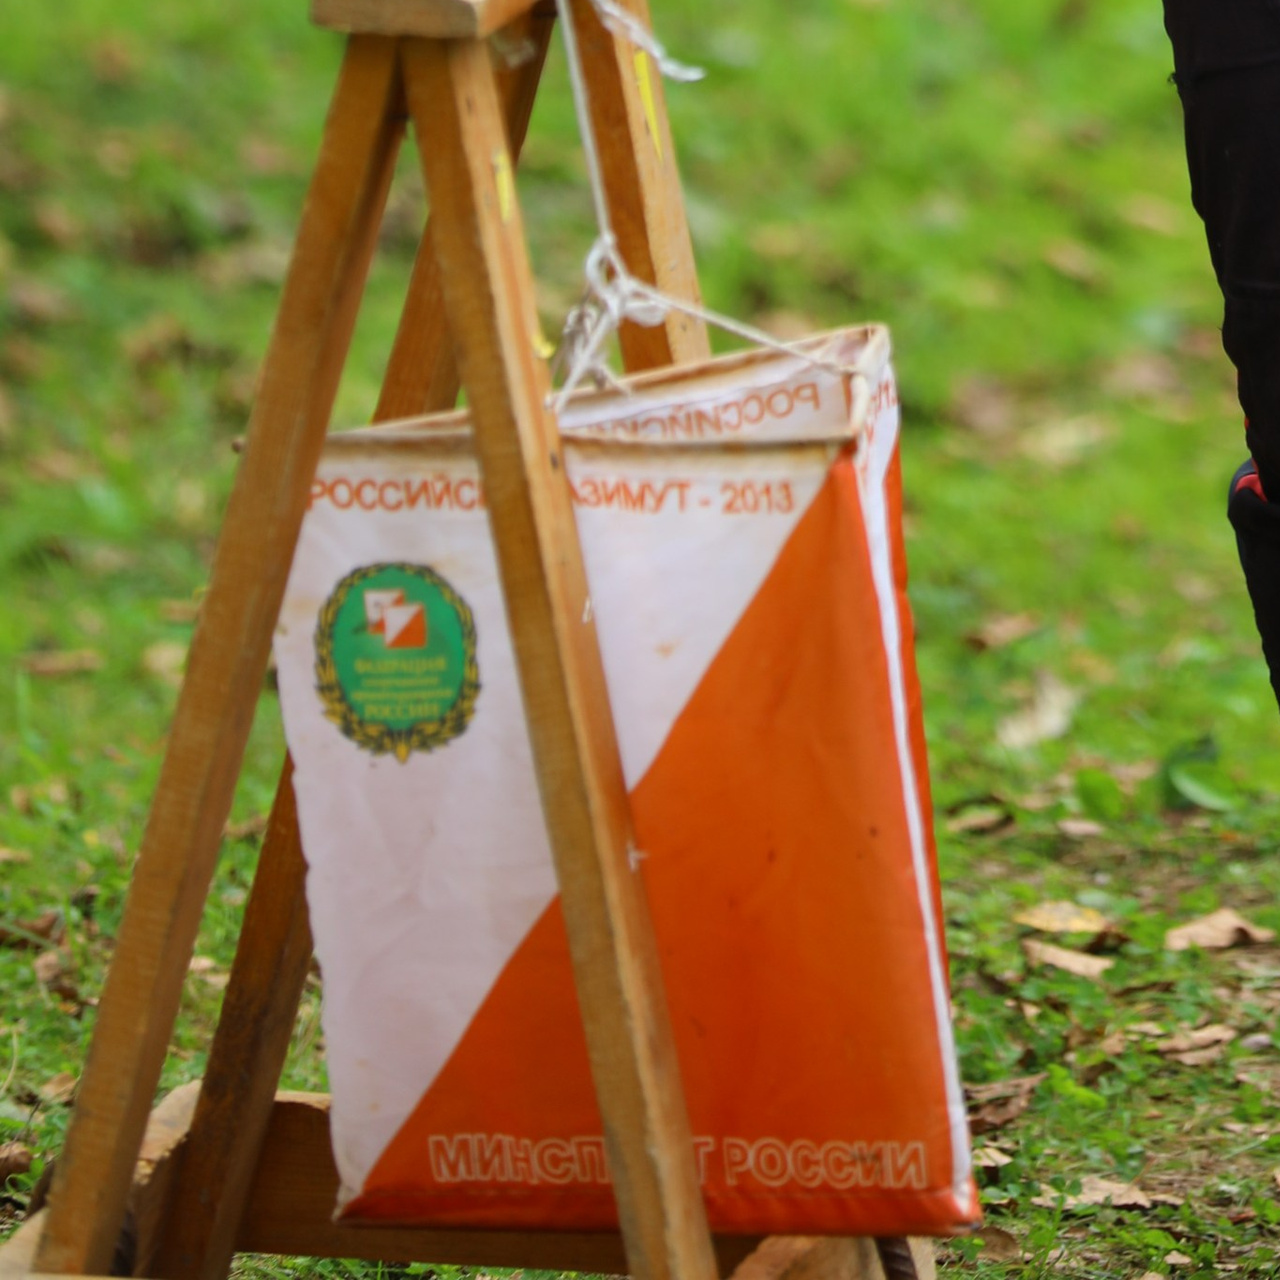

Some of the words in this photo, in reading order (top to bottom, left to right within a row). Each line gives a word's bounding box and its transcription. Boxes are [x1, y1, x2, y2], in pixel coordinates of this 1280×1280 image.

[720, 479, 796, 516] 2013
[428, 1133, 716, 1186] МИНСПТ
[723, 1138, 928, 1191] РОССИИ
